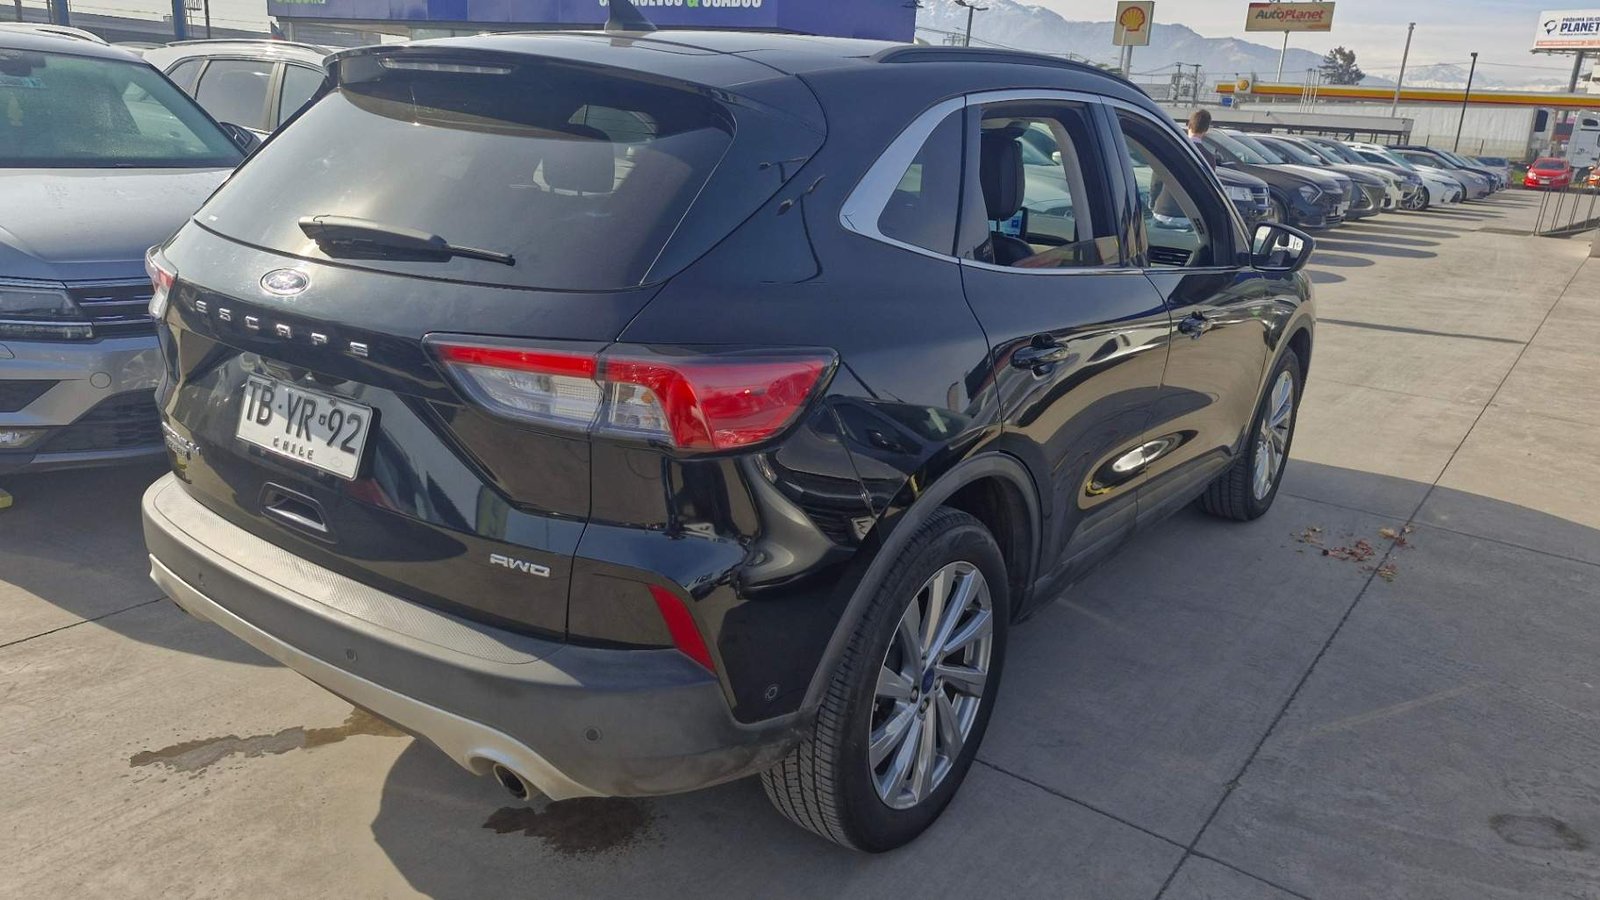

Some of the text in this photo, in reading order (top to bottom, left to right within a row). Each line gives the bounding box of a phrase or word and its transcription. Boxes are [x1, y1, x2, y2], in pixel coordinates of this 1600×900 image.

[195, 300, 369, 358] ESCAPE
[272, 437, 315, 460] CHILE
[489, 553, 551, 578] AWD
